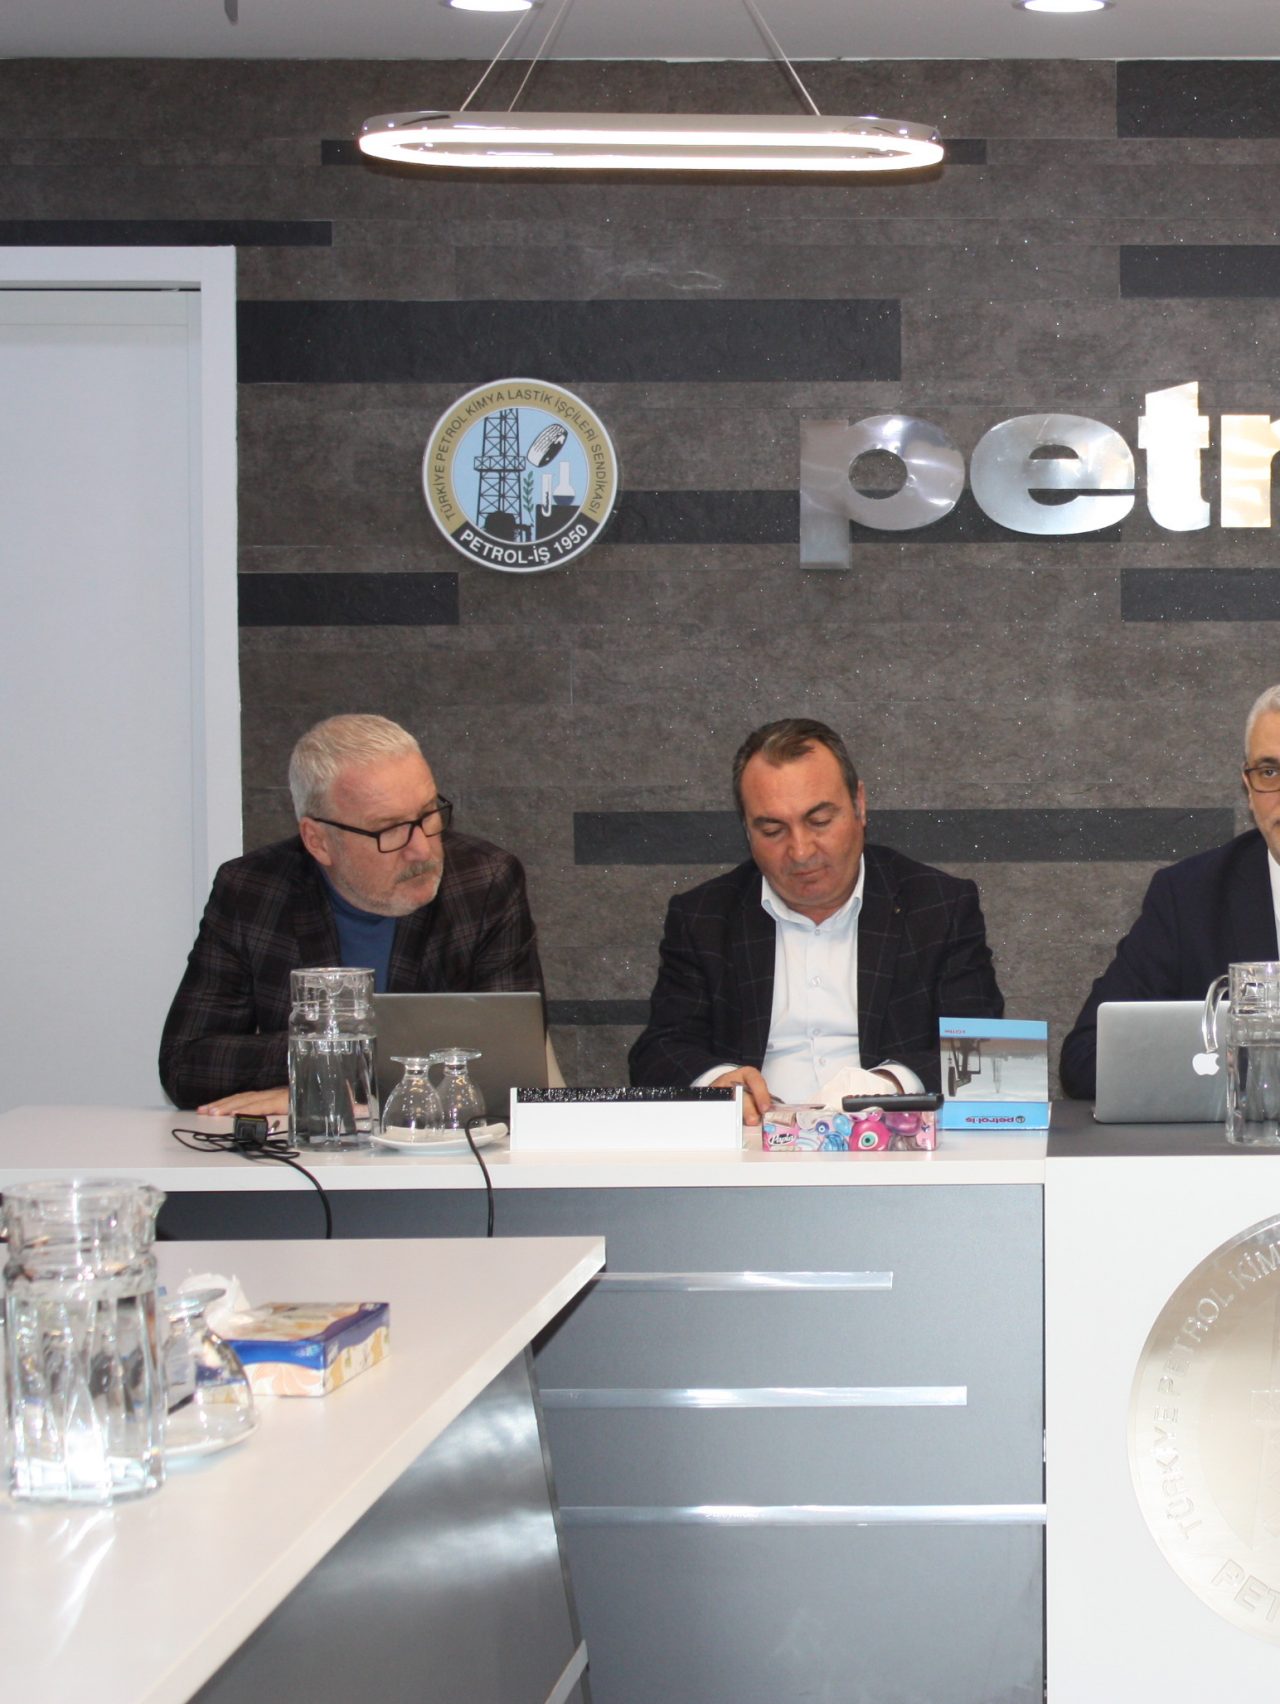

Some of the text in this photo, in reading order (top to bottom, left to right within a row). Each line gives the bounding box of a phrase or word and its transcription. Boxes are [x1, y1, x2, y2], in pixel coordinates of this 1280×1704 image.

[432, 388, 608, 521] TÜRKİYE PETROL KİMYA LASTİK İŞÇİLERİ SENDİKASI
[460, 523, 588, 565] PETROL-İŞ 1950
